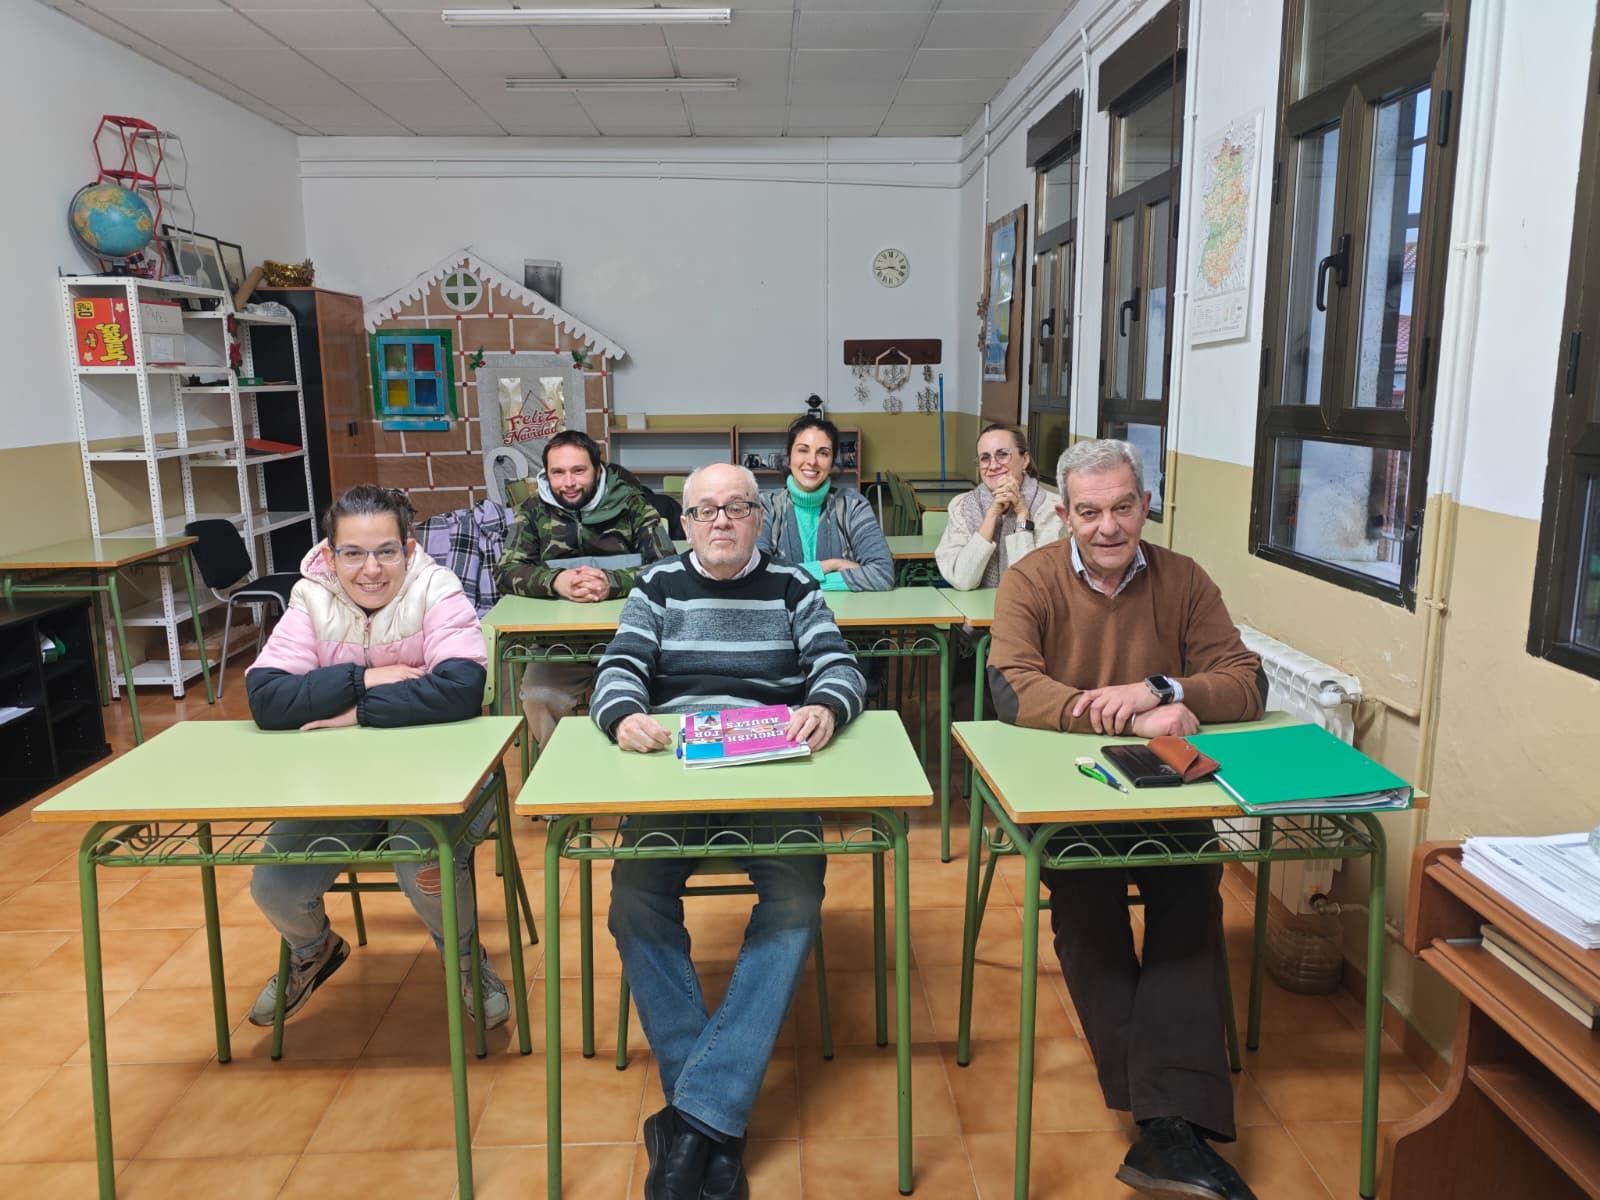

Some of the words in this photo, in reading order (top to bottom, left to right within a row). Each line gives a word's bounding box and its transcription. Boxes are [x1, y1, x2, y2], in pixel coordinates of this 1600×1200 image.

[506, 408, 561, 431] Feliz
[503, 426, 558, 445] Navidad
[726, 716, 779, 729] ADULTS
[694, 730, 720, 738] FOR
[727, 729, 785, 743] ENGLISH
